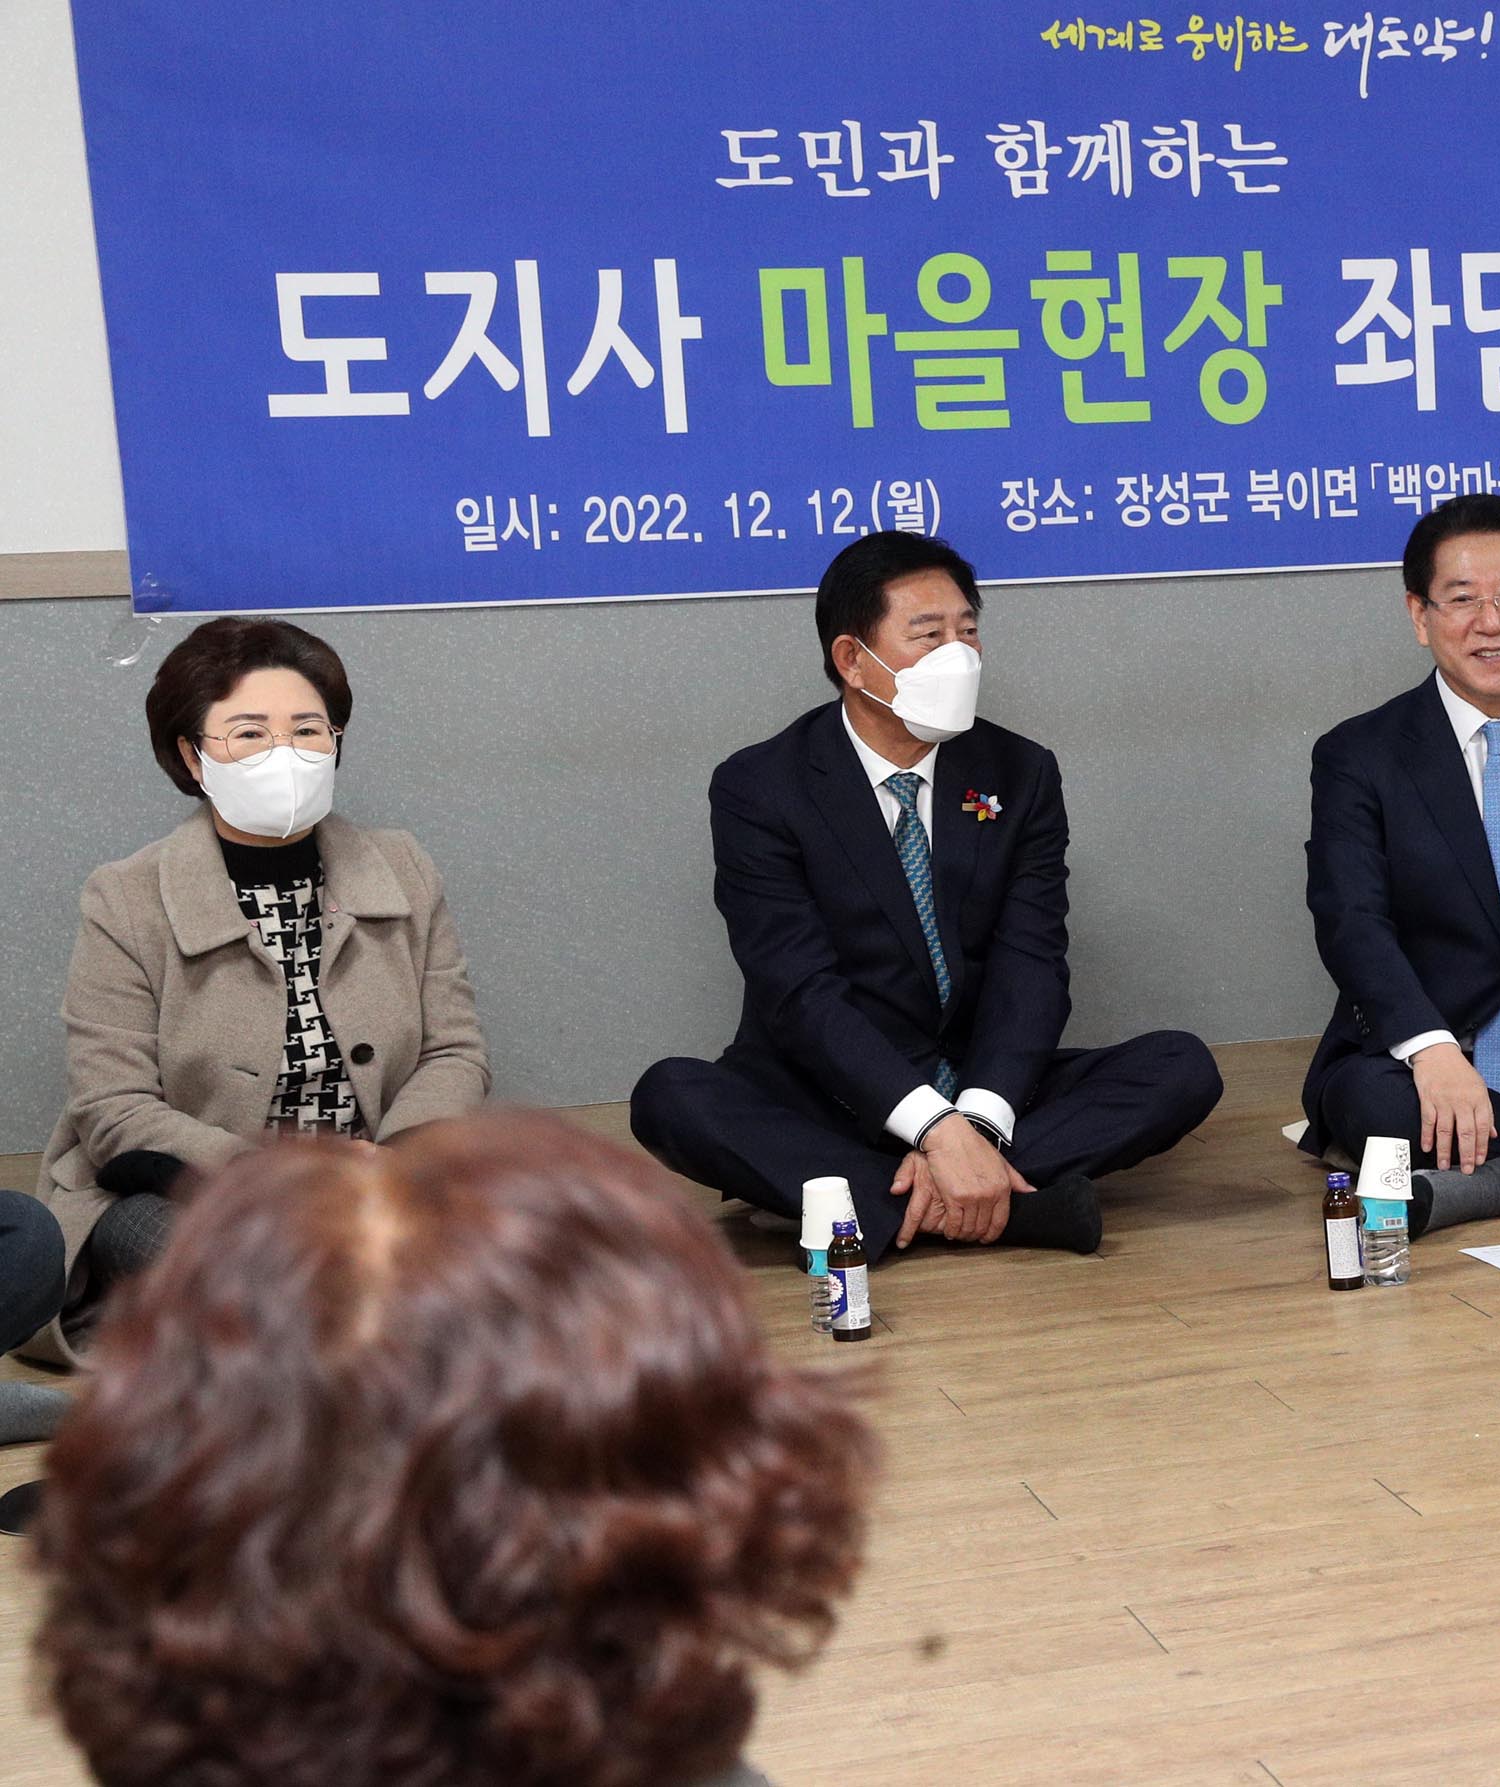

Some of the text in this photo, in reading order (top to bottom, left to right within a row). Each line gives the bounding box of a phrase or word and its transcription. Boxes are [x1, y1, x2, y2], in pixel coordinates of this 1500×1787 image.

[1040, 17, 1165, 52] 세계로
[1175, 14, 1309, 72] 웅비하는
[1323, 11, 1494, 99] 대도약!
[715, 119, 1289, 201] 도민과 함께하는
[267, 258, 703, 438] 도지사
[758, 250, 1283, 431] 마을현장
[455, 494, 560, 552] 일시:
[583, 493, 703, 543] 2022.
[724, 490, 787, 540] 12.
[1000, 477, 1094, 532] 장소:
[1114, 471, 1230, 528] 장성군
[1246, 465, 1359, 521] 북이면
